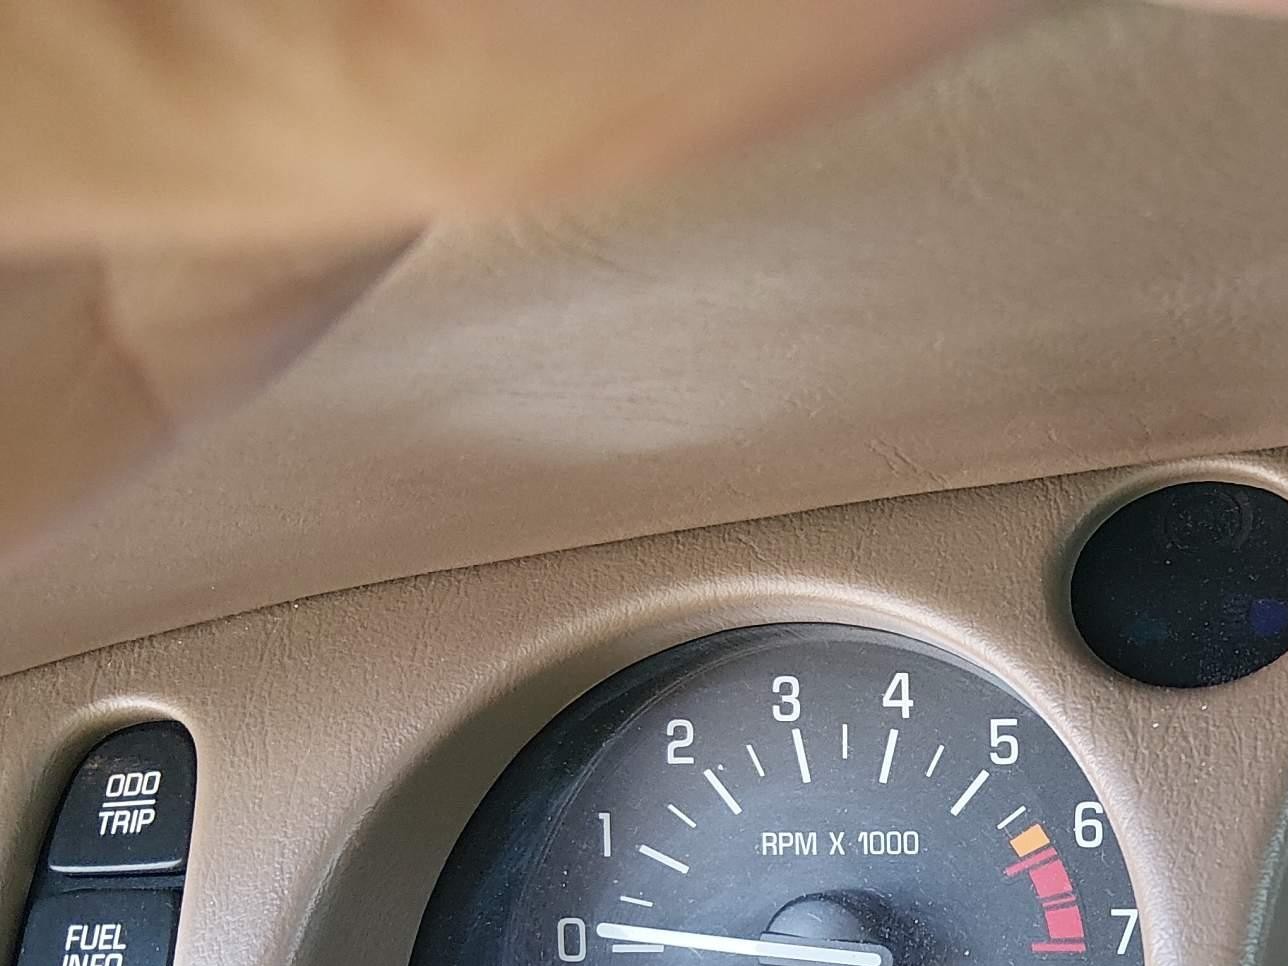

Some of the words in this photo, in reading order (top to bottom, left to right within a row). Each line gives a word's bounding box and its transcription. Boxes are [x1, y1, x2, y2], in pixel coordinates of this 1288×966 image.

[772, 675, 801, 722] 3
[882, 672, 914, 719] 4
[666, 719, 695, 765] 2
[989, 718, 1019, 765] 5
[105, 770, 162, 798] ODO
[98, 807, 156, 836] TRIP
[598, 812, 612, 858] 1
[761, 831, 818, 856] RPM
[828, 831, 845, 856] X
[857, 830, 919, 855] 1000
[1074, 802, 1105, 849] 6
[64, 923, 127, 952] FUEL
[557, 917, 587, 963] 0
[1110, 908, 1138, 955] 7
